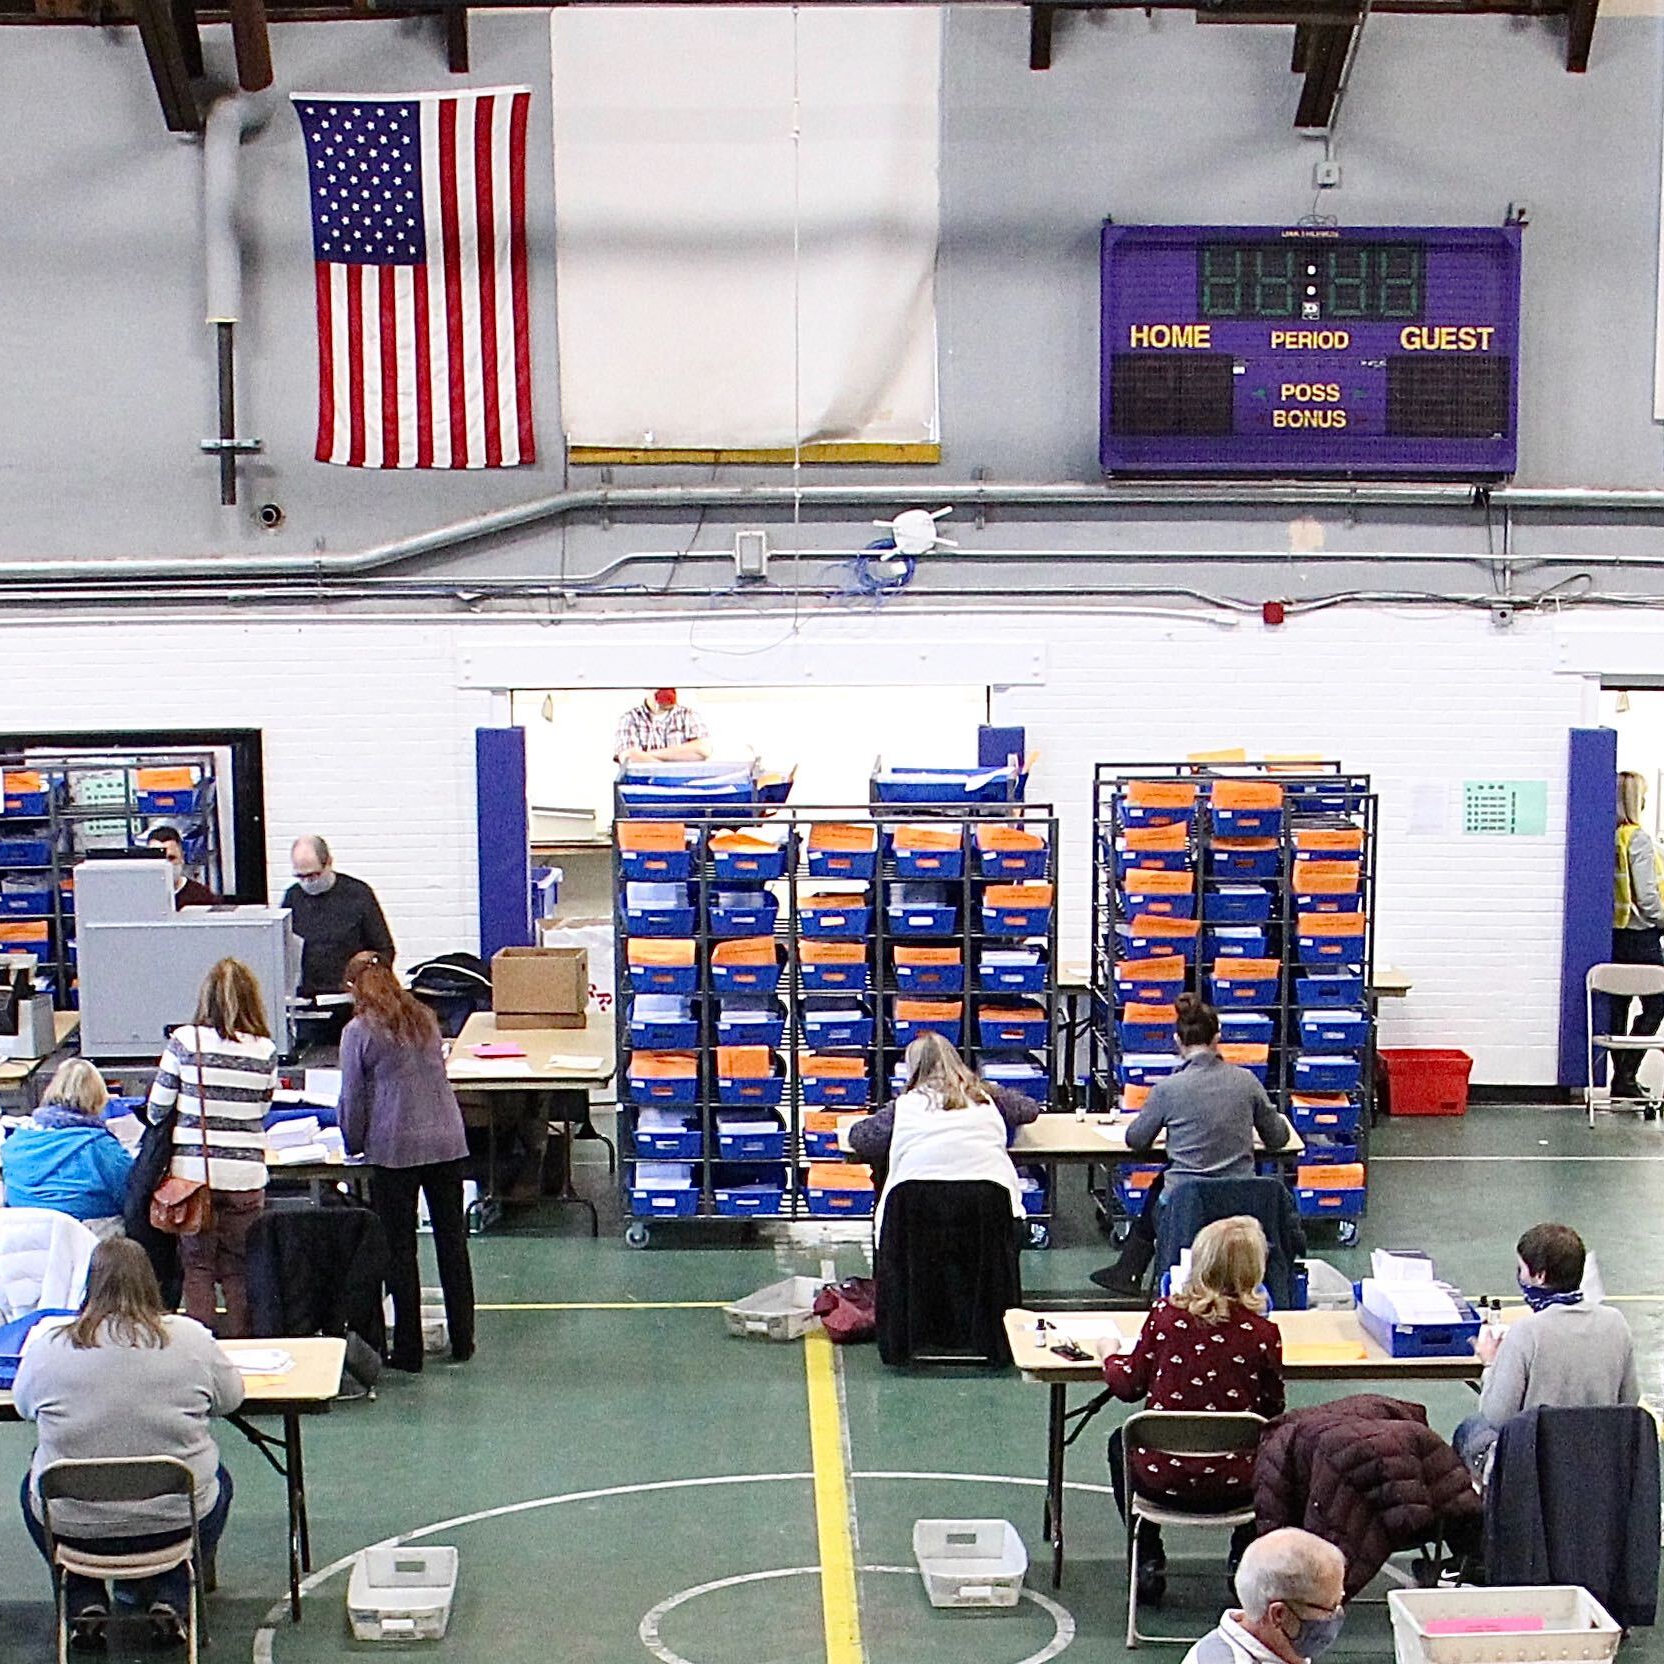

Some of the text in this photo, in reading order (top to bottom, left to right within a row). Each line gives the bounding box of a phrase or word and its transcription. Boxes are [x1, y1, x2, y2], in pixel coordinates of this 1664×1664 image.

[1130, 324, 1211, 348] HOME
[1271, 330, 1349, 350] PERIOD
[1400, 326, 1495, 351] GUEST
[1280, 383, 1341, 402] POSS
[1272, 409, 1347, 428] BONUS
